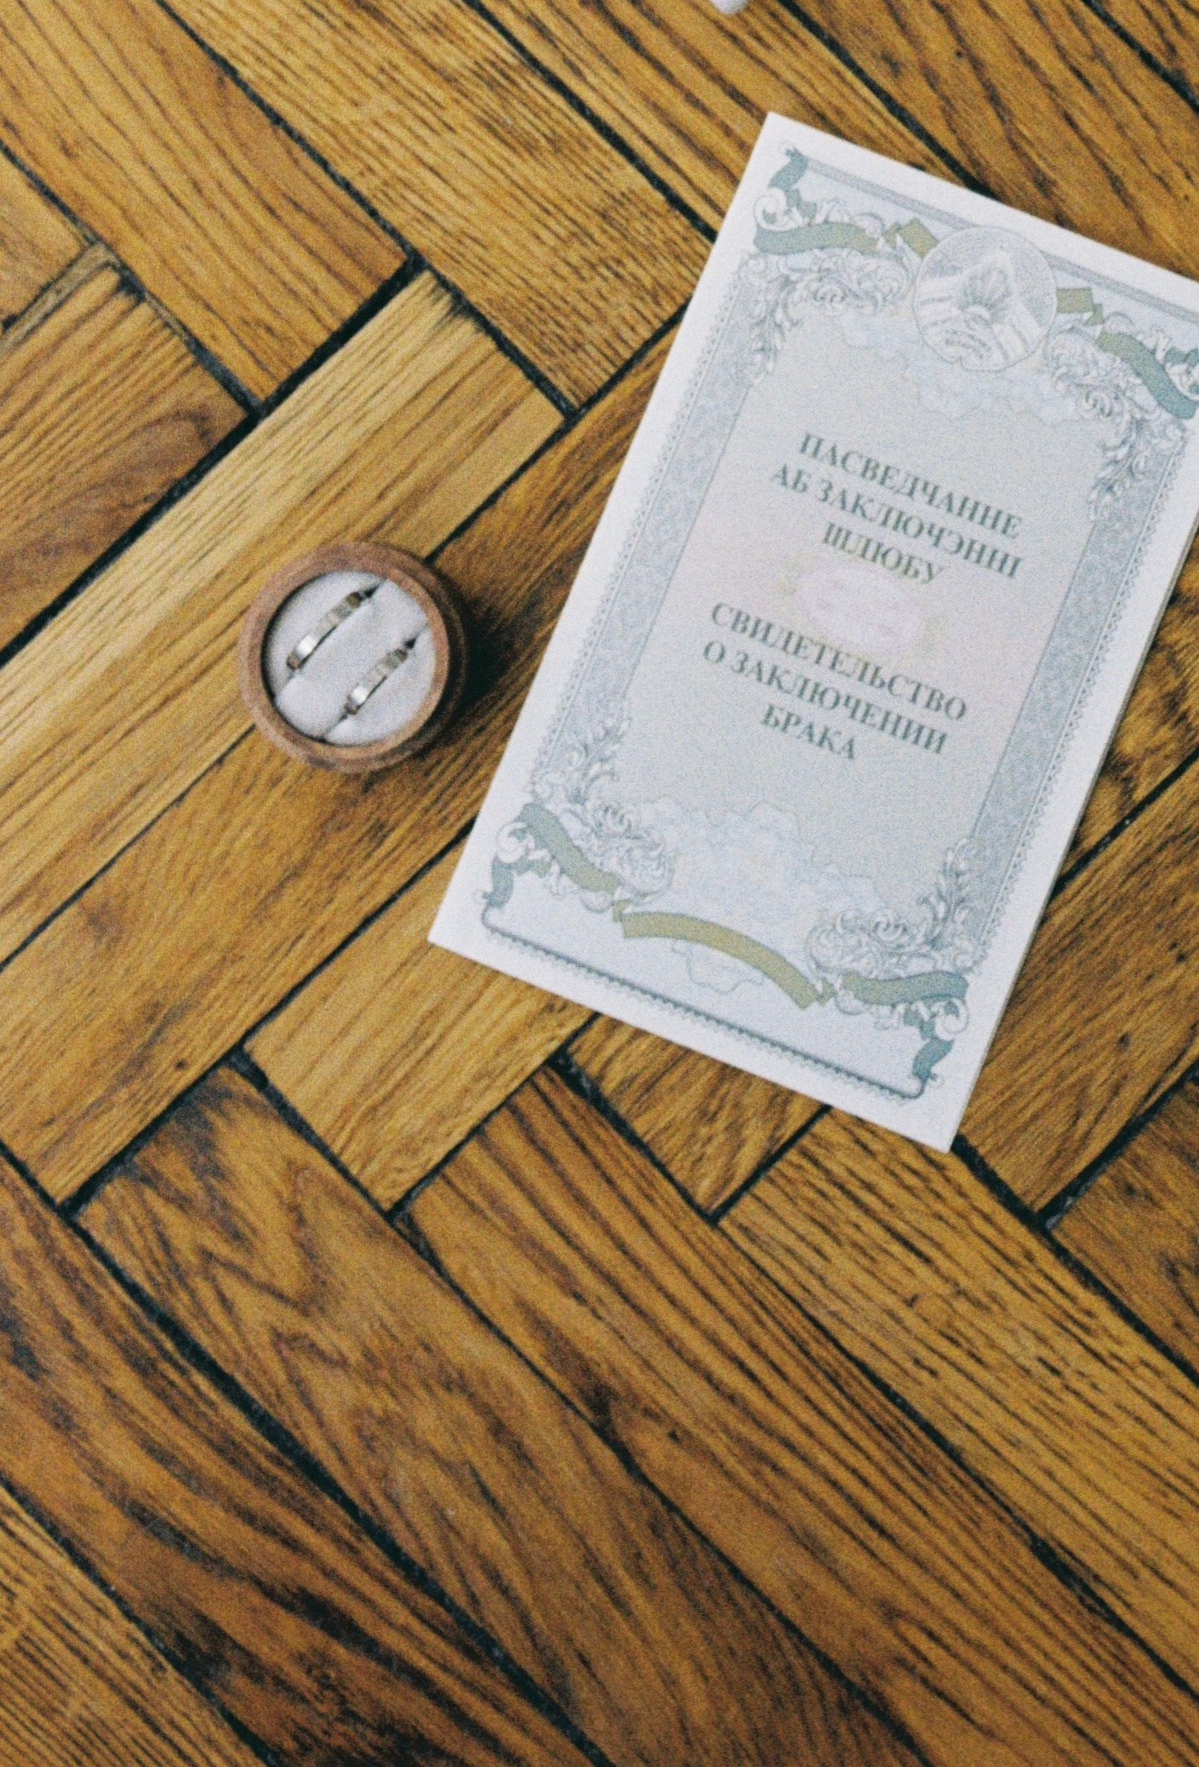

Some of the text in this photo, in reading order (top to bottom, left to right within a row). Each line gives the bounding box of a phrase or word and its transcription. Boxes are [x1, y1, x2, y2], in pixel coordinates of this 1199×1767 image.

[771, 464, 1022, 579] АБ ЗАКЛЮЧЭННІ
[799, 433, 1022, 539] ПАСВЕДЧАННЕ
[821, 522, 945, 583] ШЛЮБУ
[703, 640, 948, 755] О ЗАКЛЮЧЕНИИ
[710, 601, 967, 721] СВИДЕТЕЛЬСТВО
[760, 703, 856, 760] БРАКА
